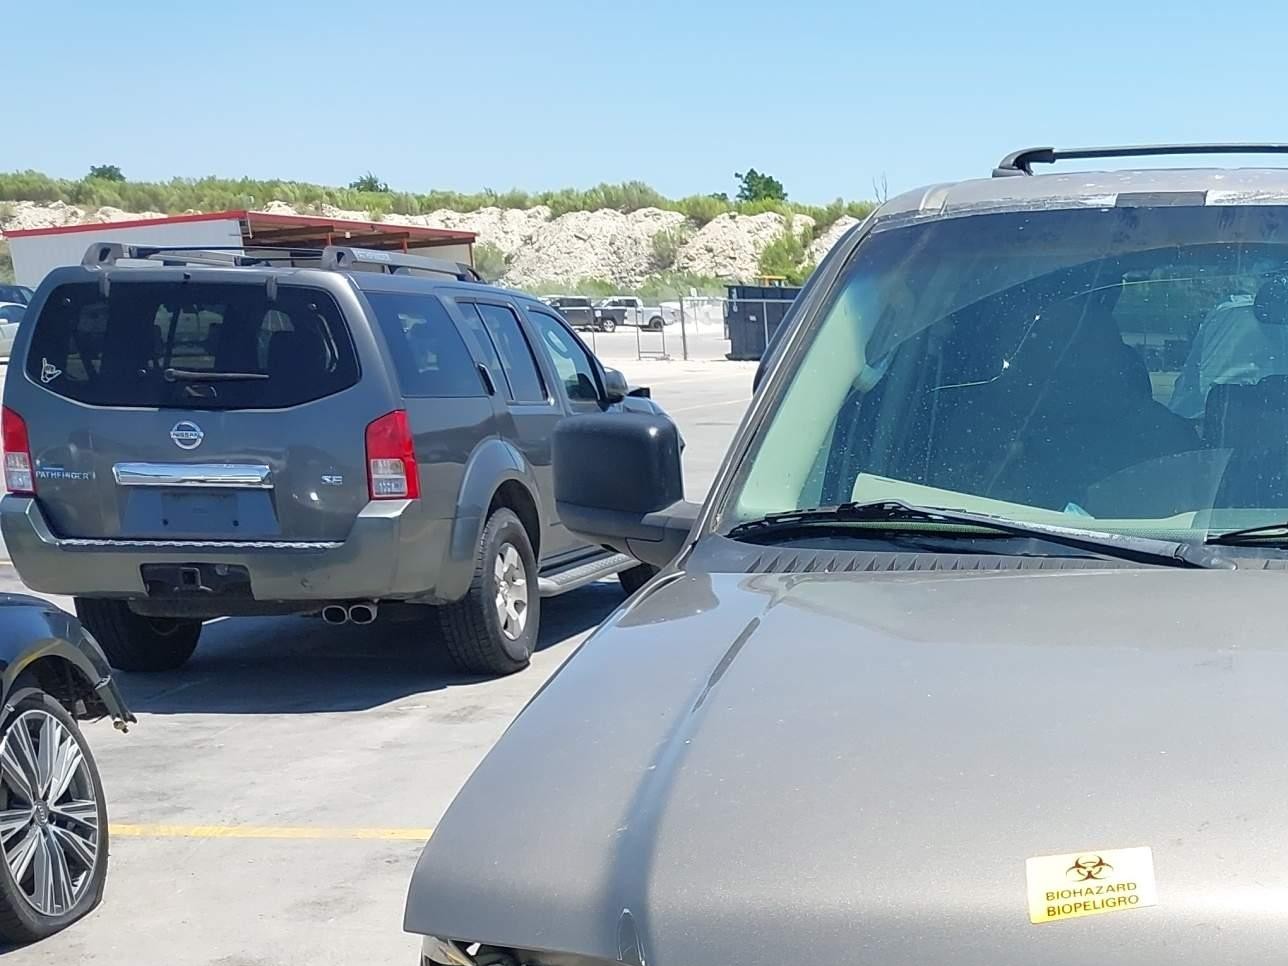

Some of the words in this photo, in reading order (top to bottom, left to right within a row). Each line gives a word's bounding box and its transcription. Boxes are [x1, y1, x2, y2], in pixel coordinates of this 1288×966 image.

[321, 475, 343, 485] SE
[1045, 882, 1137, 901] BIOHAZARD
[1047, 895, 1140, 917] BIOPELIGRO
